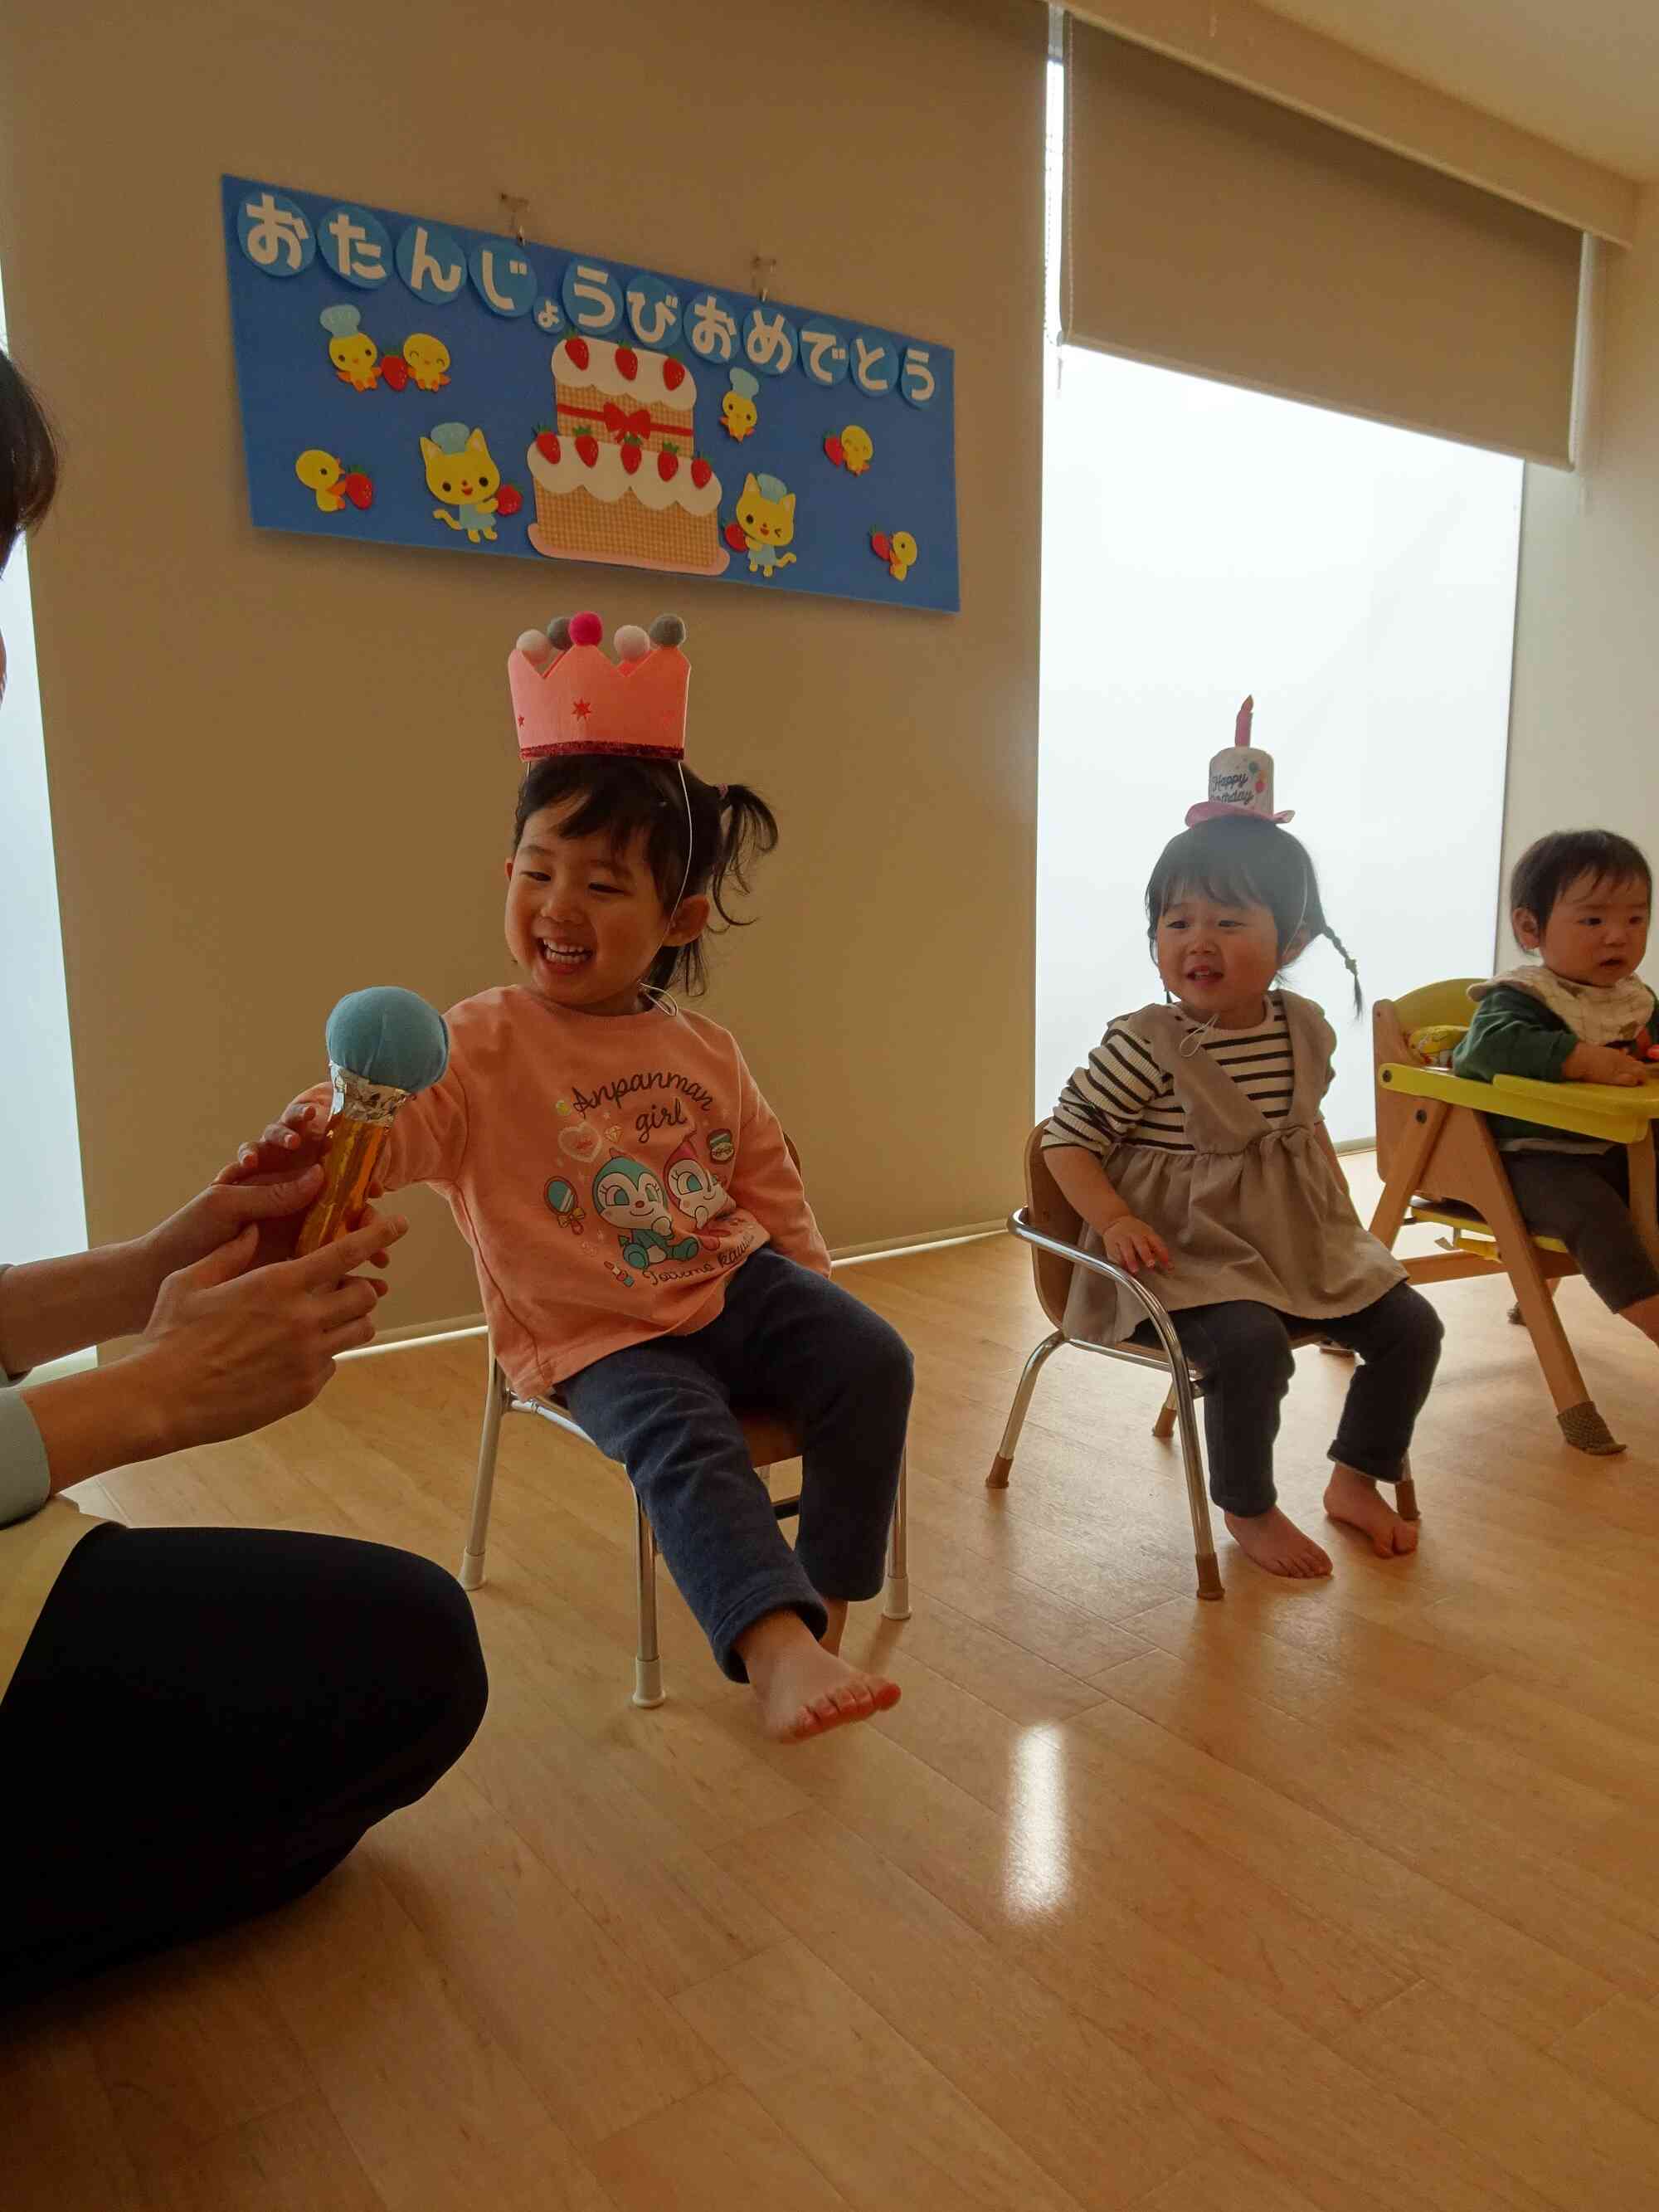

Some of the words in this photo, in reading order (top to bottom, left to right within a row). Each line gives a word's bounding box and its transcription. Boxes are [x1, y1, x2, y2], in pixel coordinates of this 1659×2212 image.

[246, 192, 936, 402] おたんじょうびおめでとう
[1211, 772, 1248, 792] Happy
[572, 1071, 713, 1118] Anpanman
[635, 1097, 688, 1143] girl
